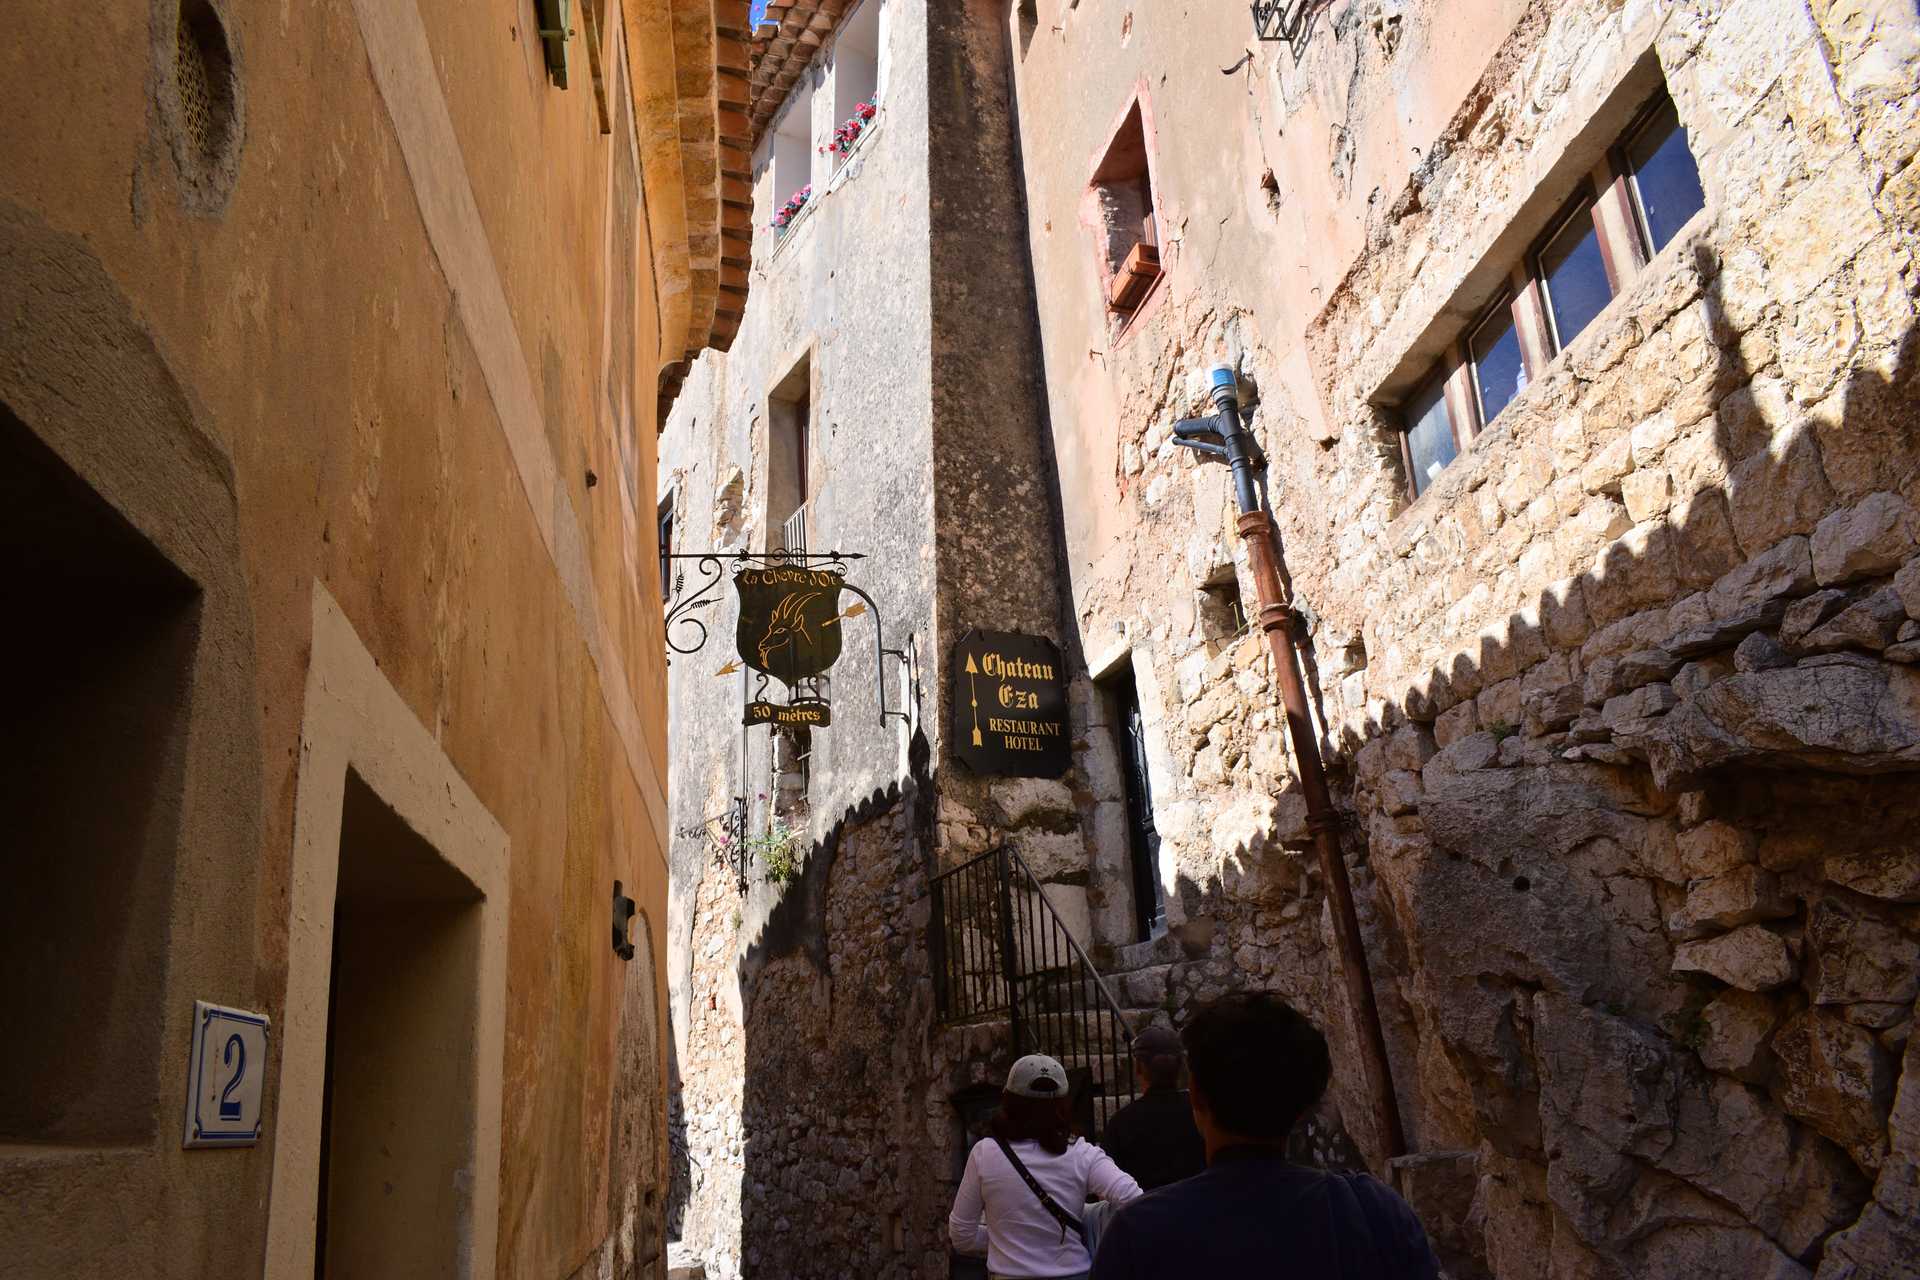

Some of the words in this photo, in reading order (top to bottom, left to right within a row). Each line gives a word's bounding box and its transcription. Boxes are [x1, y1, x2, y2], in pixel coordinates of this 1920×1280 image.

[982, 652, 1054, 681] Chateau
[998, 683, 1040, 709] Eza
[753, 705, 771, 719] 50
[989, 718, 1061, 736] RESTAURANT
[1004, 735, 1044, 751] HOTEL
[219, 1033, 246, 1121] 2
